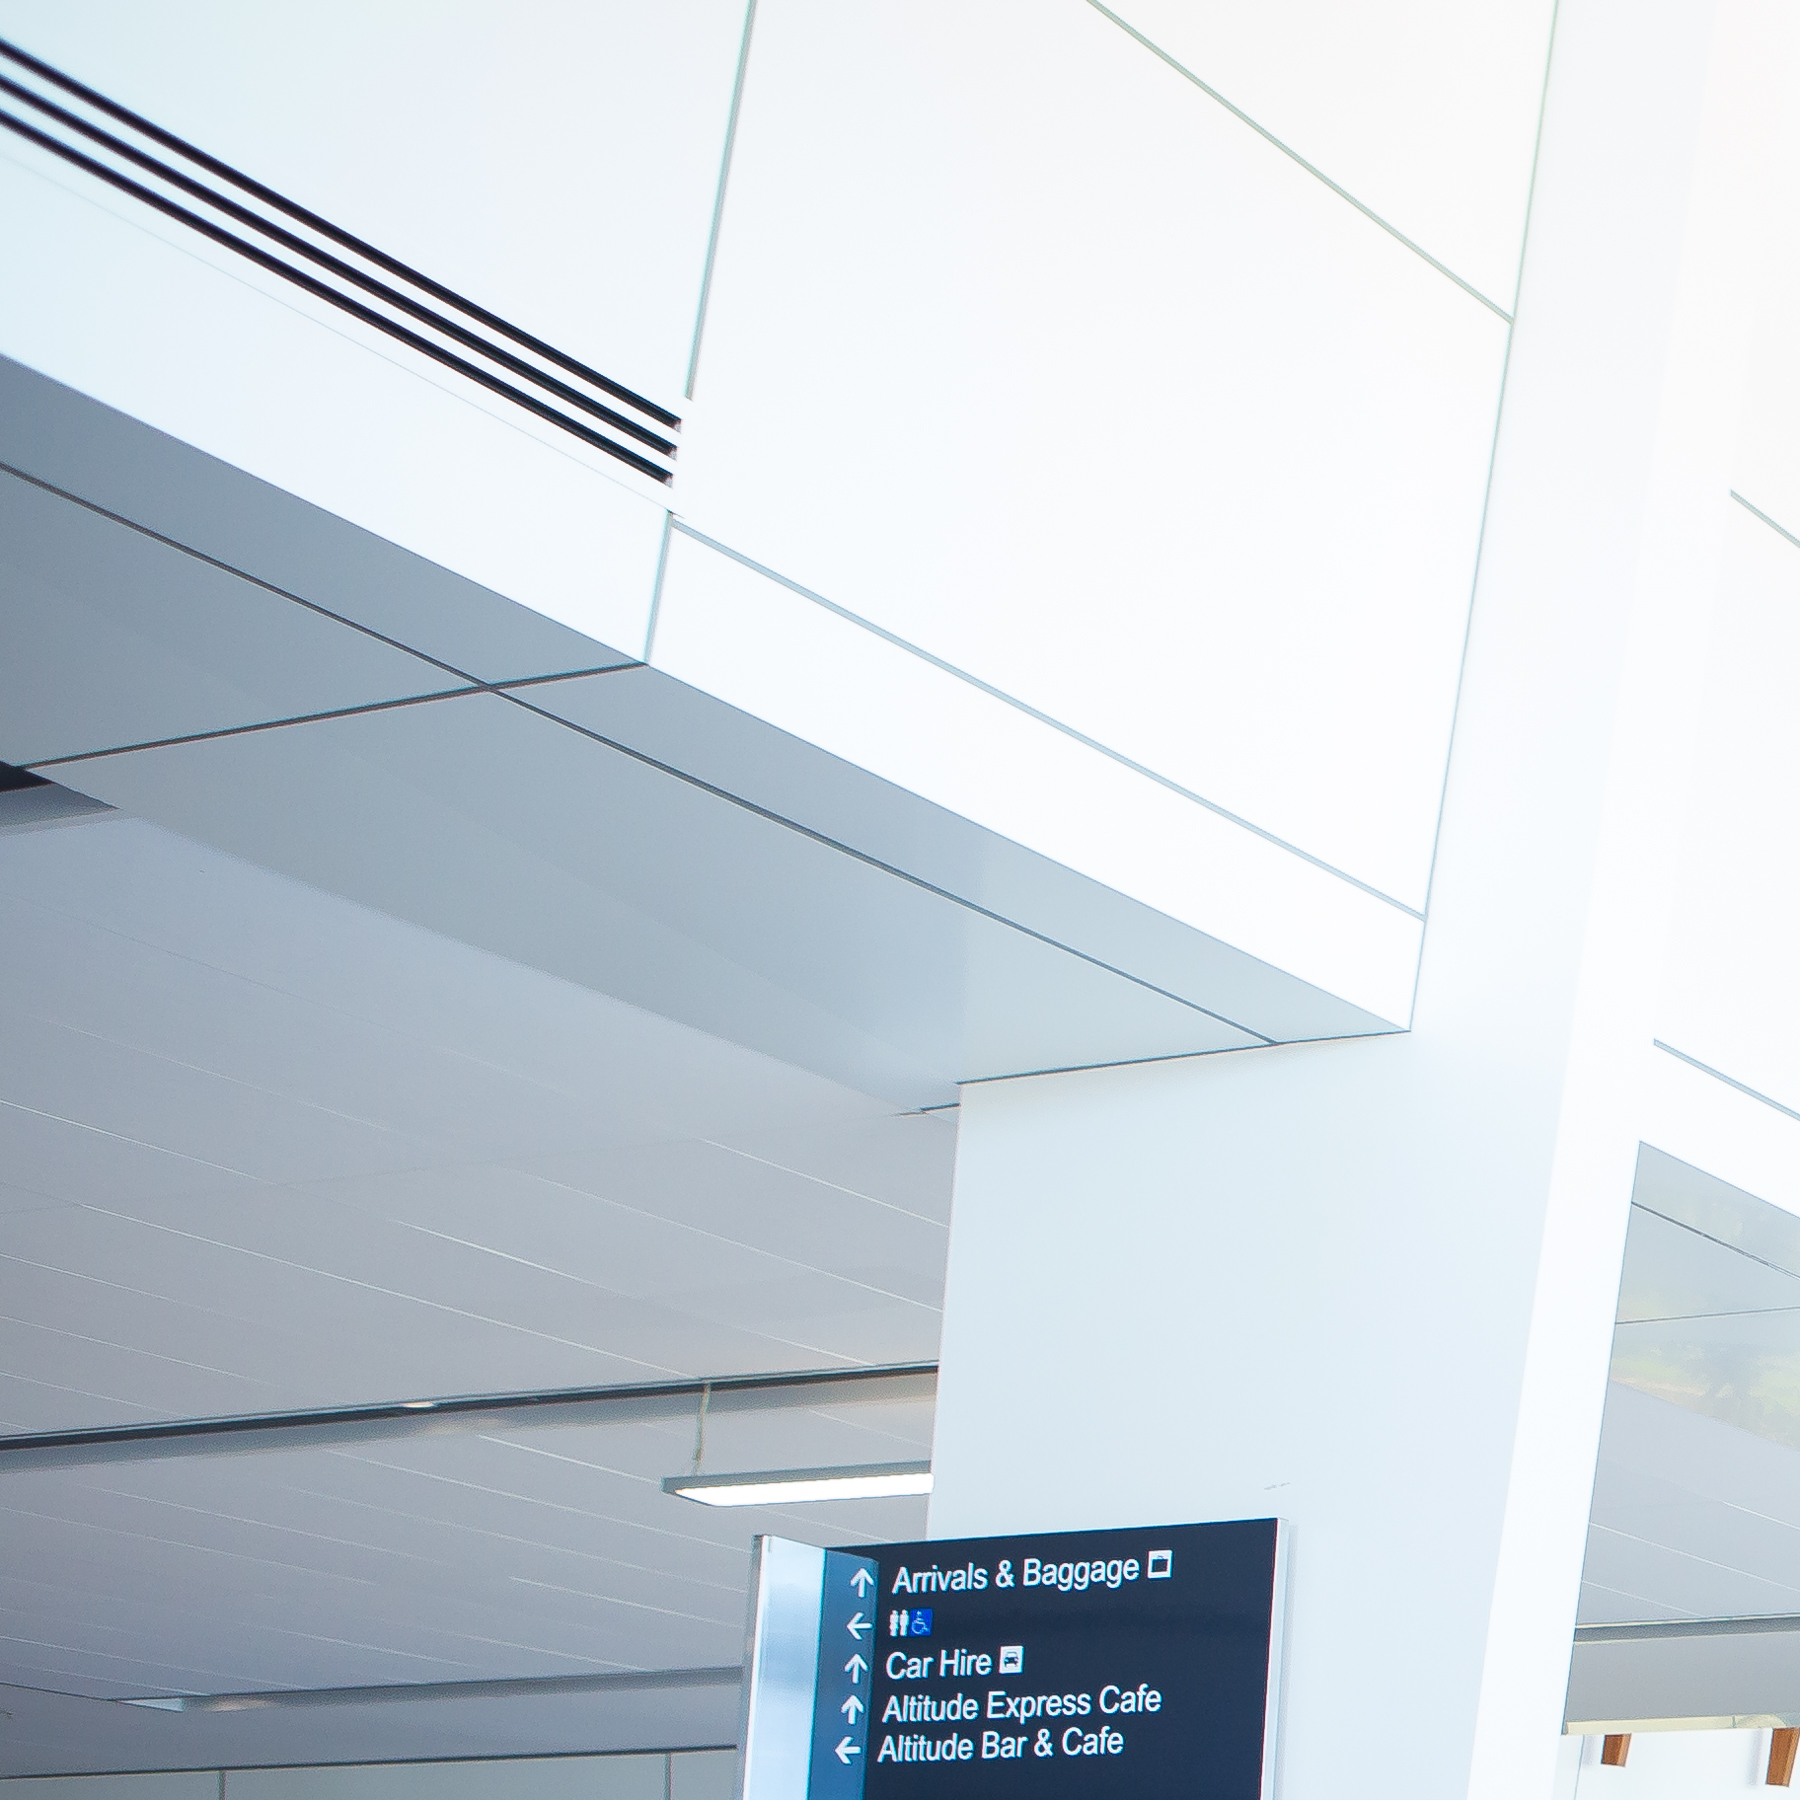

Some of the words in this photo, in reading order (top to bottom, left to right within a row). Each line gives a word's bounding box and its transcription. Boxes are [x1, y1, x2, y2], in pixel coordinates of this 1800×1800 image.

[891, 1560, 988, 1594] Arrivals
[995, 1559, 1016, 1589] &
[1023, 1556, 1140, 1593] Baggage
[885, 1651, 934, 1680] Car
[940, 1649, 993, 1677] Hire
[881, 1693, 979, 1724] Altitude
[986, 1690, 1092, 1726] Express
[1099, 1684, 1163, 1713] Cafe
[877, 1732, 974, 1763] Altitude
[981, 1732, 1027, 1760] Bar
[1034, 1729, 1055, 1758] &
[1061, 1726, 1125, 1756] Cafe
